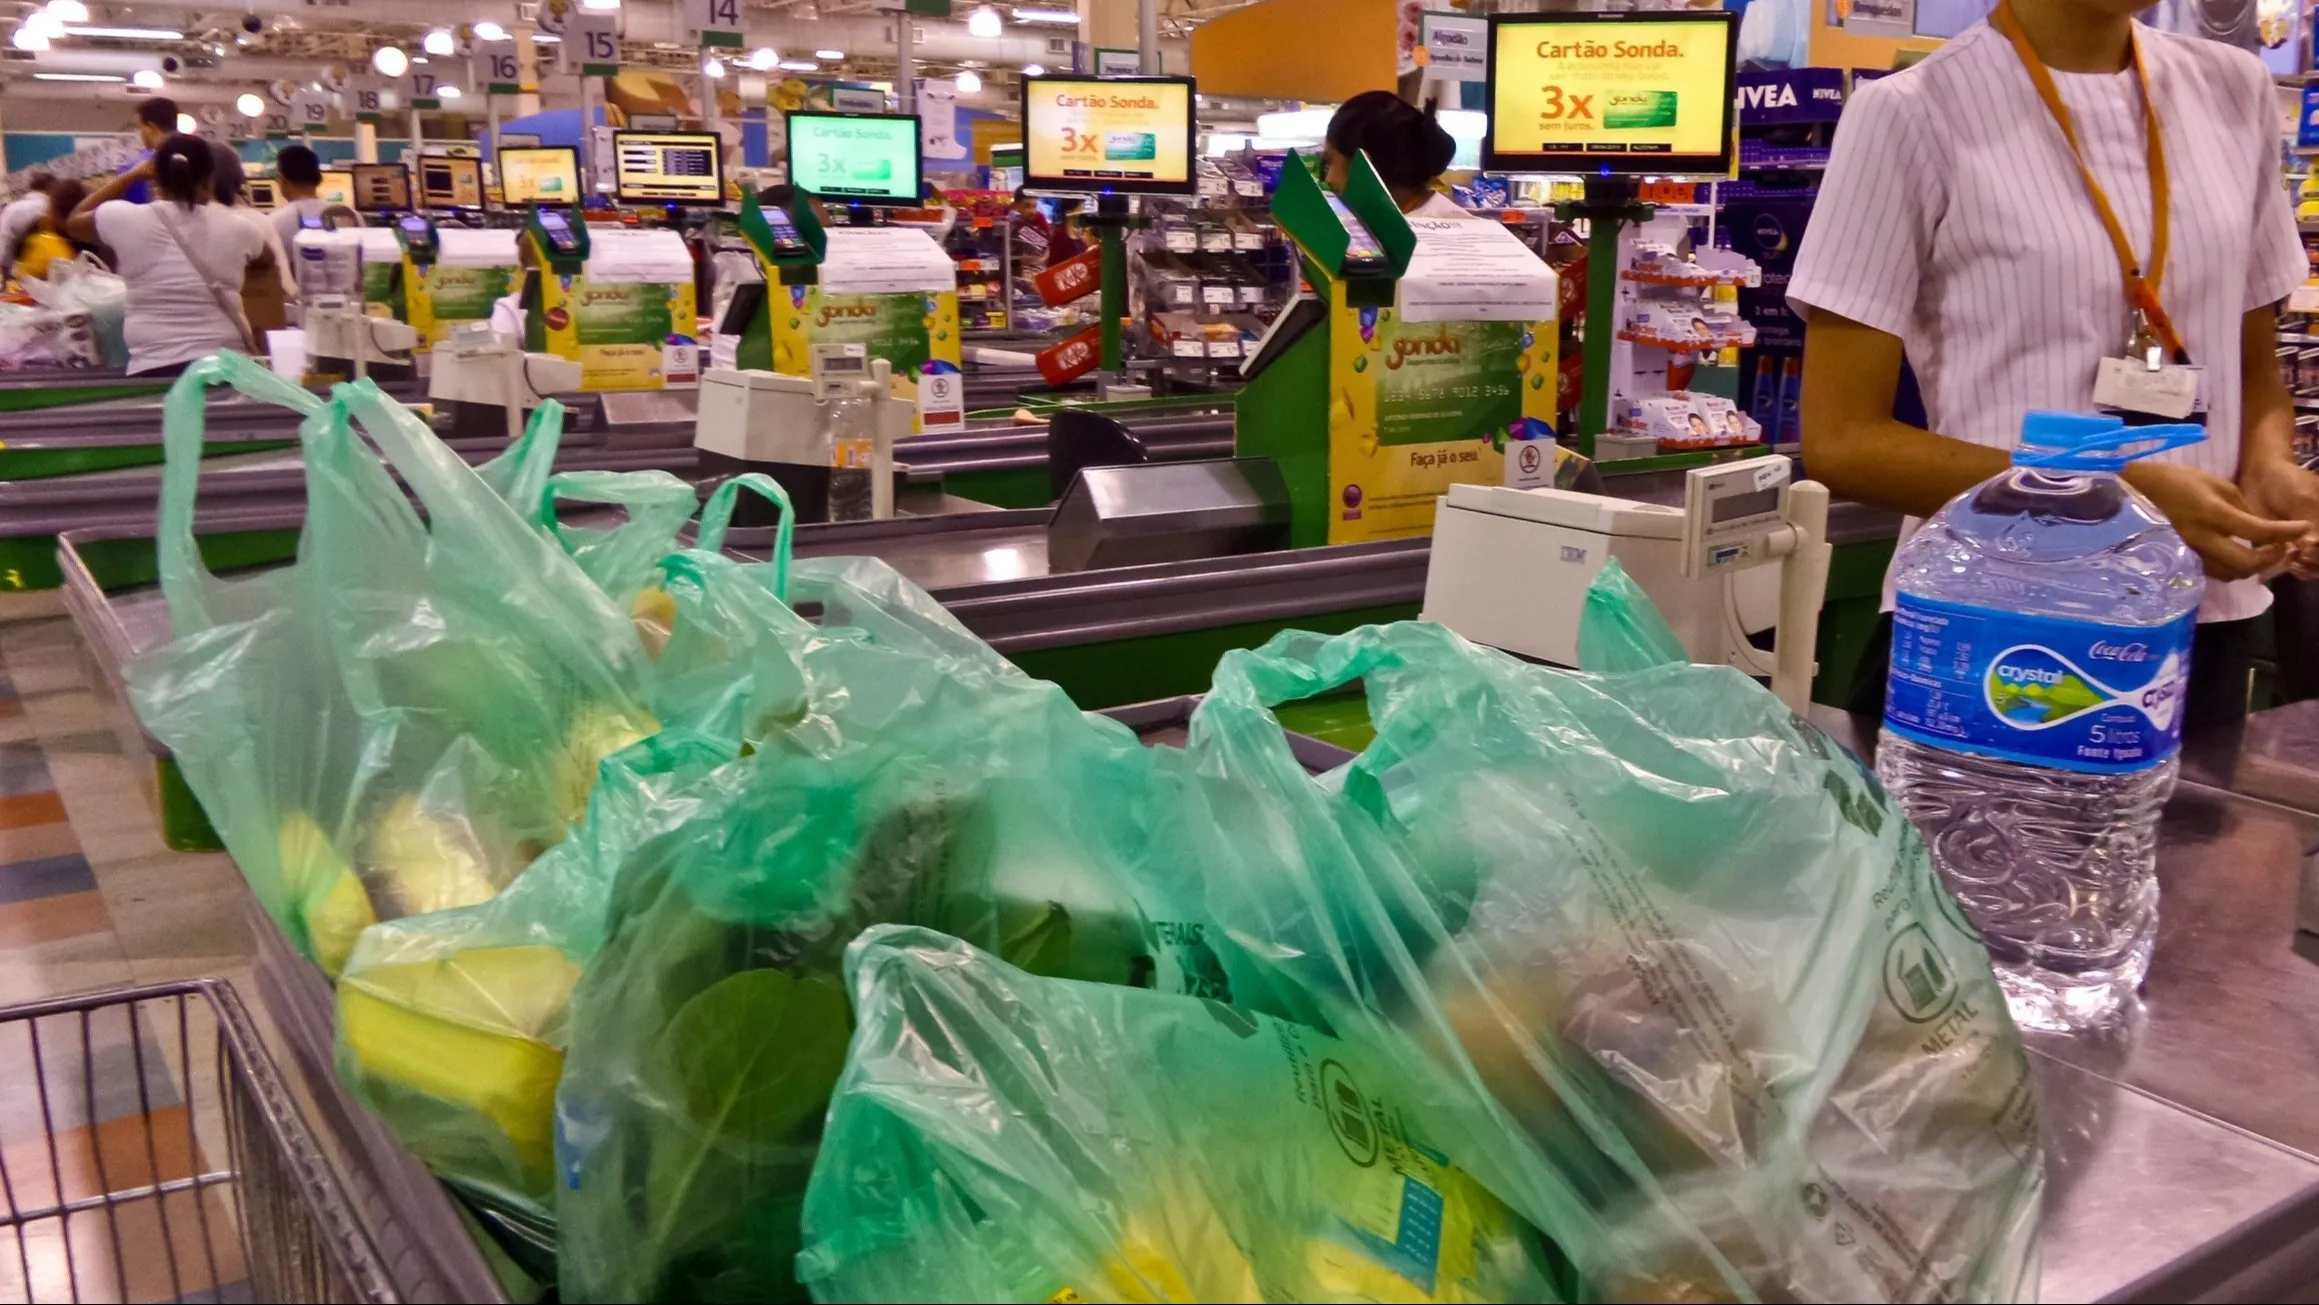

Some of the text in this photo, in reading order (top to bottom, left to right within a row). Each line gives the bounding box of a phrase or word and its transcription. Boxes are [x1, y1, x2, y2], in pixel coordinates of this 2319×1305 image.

[708, 0, 738, 25] 14
[586, 31, 614, 59] 15
[1536, 39, 1685, 58] Cartão Sonda.
[490, 54, 517, 79] 16
[412, 74, 435, 95] 17
[1812, 88, 1842, 100] NIVEA
[358, 90, 380, 109] 18
[1056, 93, 1160, 109] Cartão Sonda.
[1540, 85, 1594, 120] 3x
[1737, 82, 1798, 110] IVEA
[266, 114, 288, 130] 20
[305, 103, 325, 120] 19
[1060, 127, 1098, 153] 3x
[817, 153, 847, 174] 3x
[1386, 325, 1461, 371] sonda
[1411, 451, 1435, 469] Faça
[1437, 449, 1448, 468] já
[1450, 453, 1457, 463] o
[1561, 545, 1587, 565] IBM
[1997, 664, 2063, 685] crystal
[2089, 725, 2105, 743] 5
[1921, 1002, 1979, 1056] METAL
